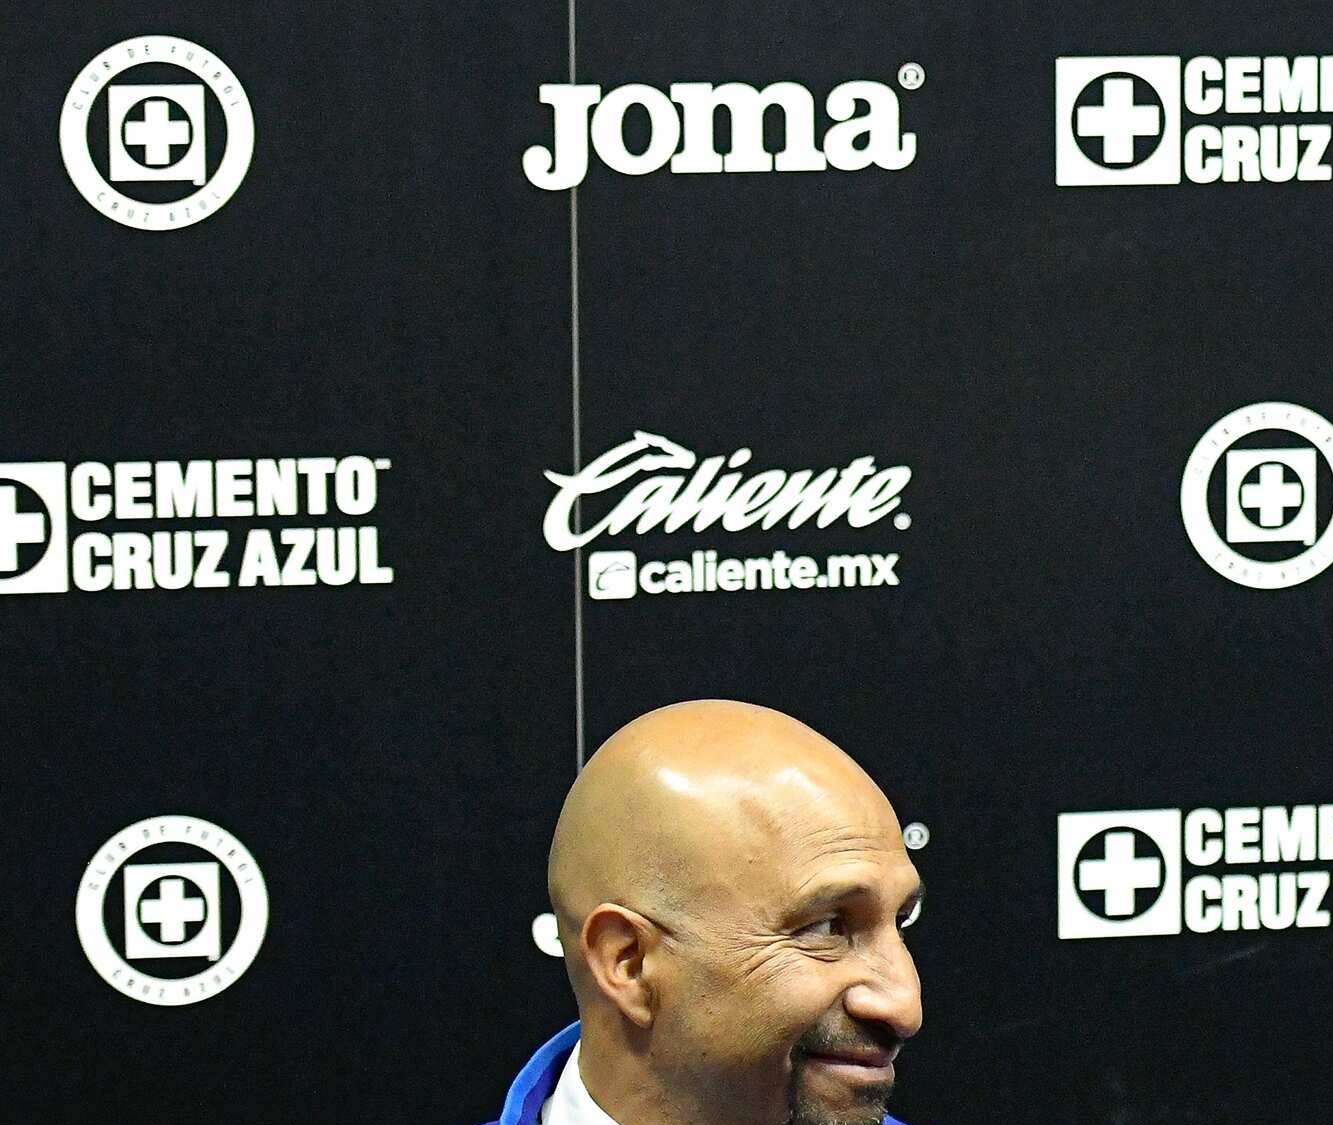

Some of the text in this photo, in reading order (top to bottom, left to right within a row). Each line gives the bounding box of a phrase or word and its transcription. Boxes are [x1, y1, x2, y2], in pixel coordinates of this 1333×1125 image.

[1185, 124, 1332, 183] CRUZ
[71, 457, 378, 521] CEMENTO
[543, 431, 911, 551] Caliente
[73, 527, 393, 591] CRUZ AZUL
[639, 550, 899, 593] caliente.mx
[1185, 872, 1330, 933] CRUZ
